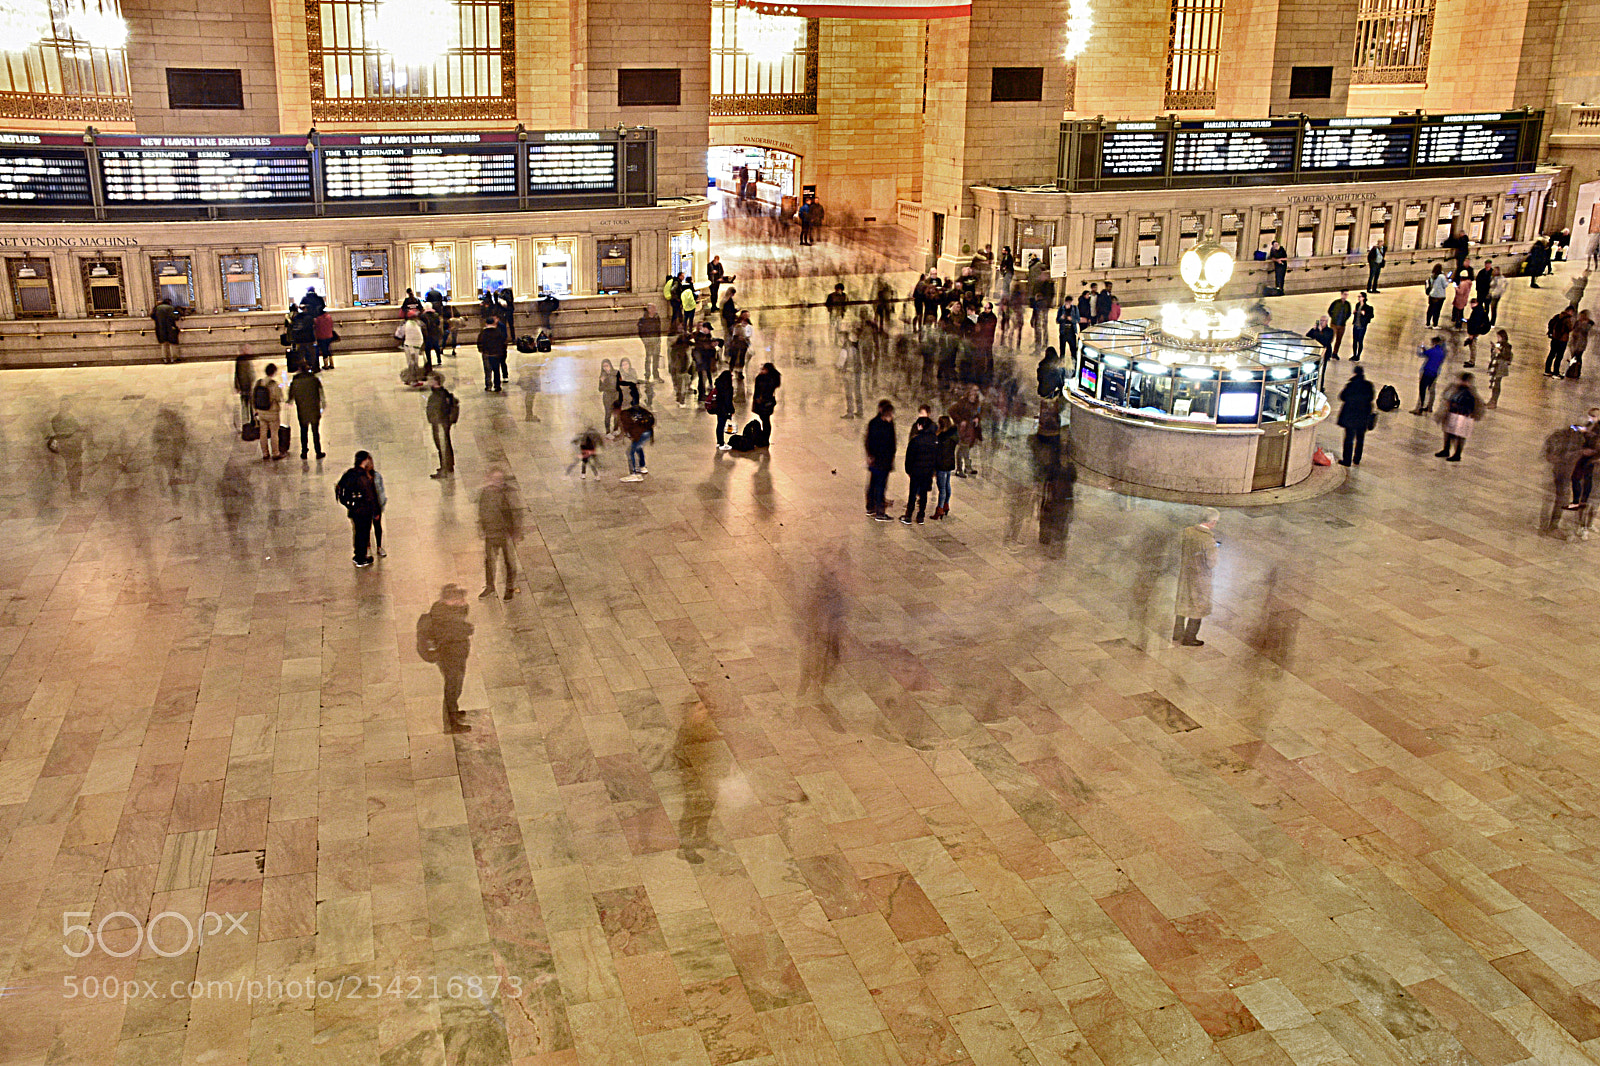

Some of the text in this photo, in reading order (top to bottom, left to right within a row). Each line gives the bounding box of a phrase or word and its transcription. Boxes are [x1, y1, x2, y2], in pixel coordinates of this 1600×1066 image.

[1116, 122, 1157, 130] INFORMATION
[1203, 121, 1227, 129] HARLEM
[1240, 120, 1271, 128] DEPARTURES
[360, 134, 480, 144] NEW HAVEN LINE DEPARTURES
[544, 132, 599, 141] INFORMATION
[140, 137, 271, 146] NEW HAVEN LINE DEPARTURES
[743, 136, 793, 149] VANDERBILT HALL
[1302, 193, 1351, 203] METRO-NORTH
[1351, 192, 1377, 201] TICKETS
[21, 237, 76, 246] VENDING
[79, 237, 138, 247] MACHINES
